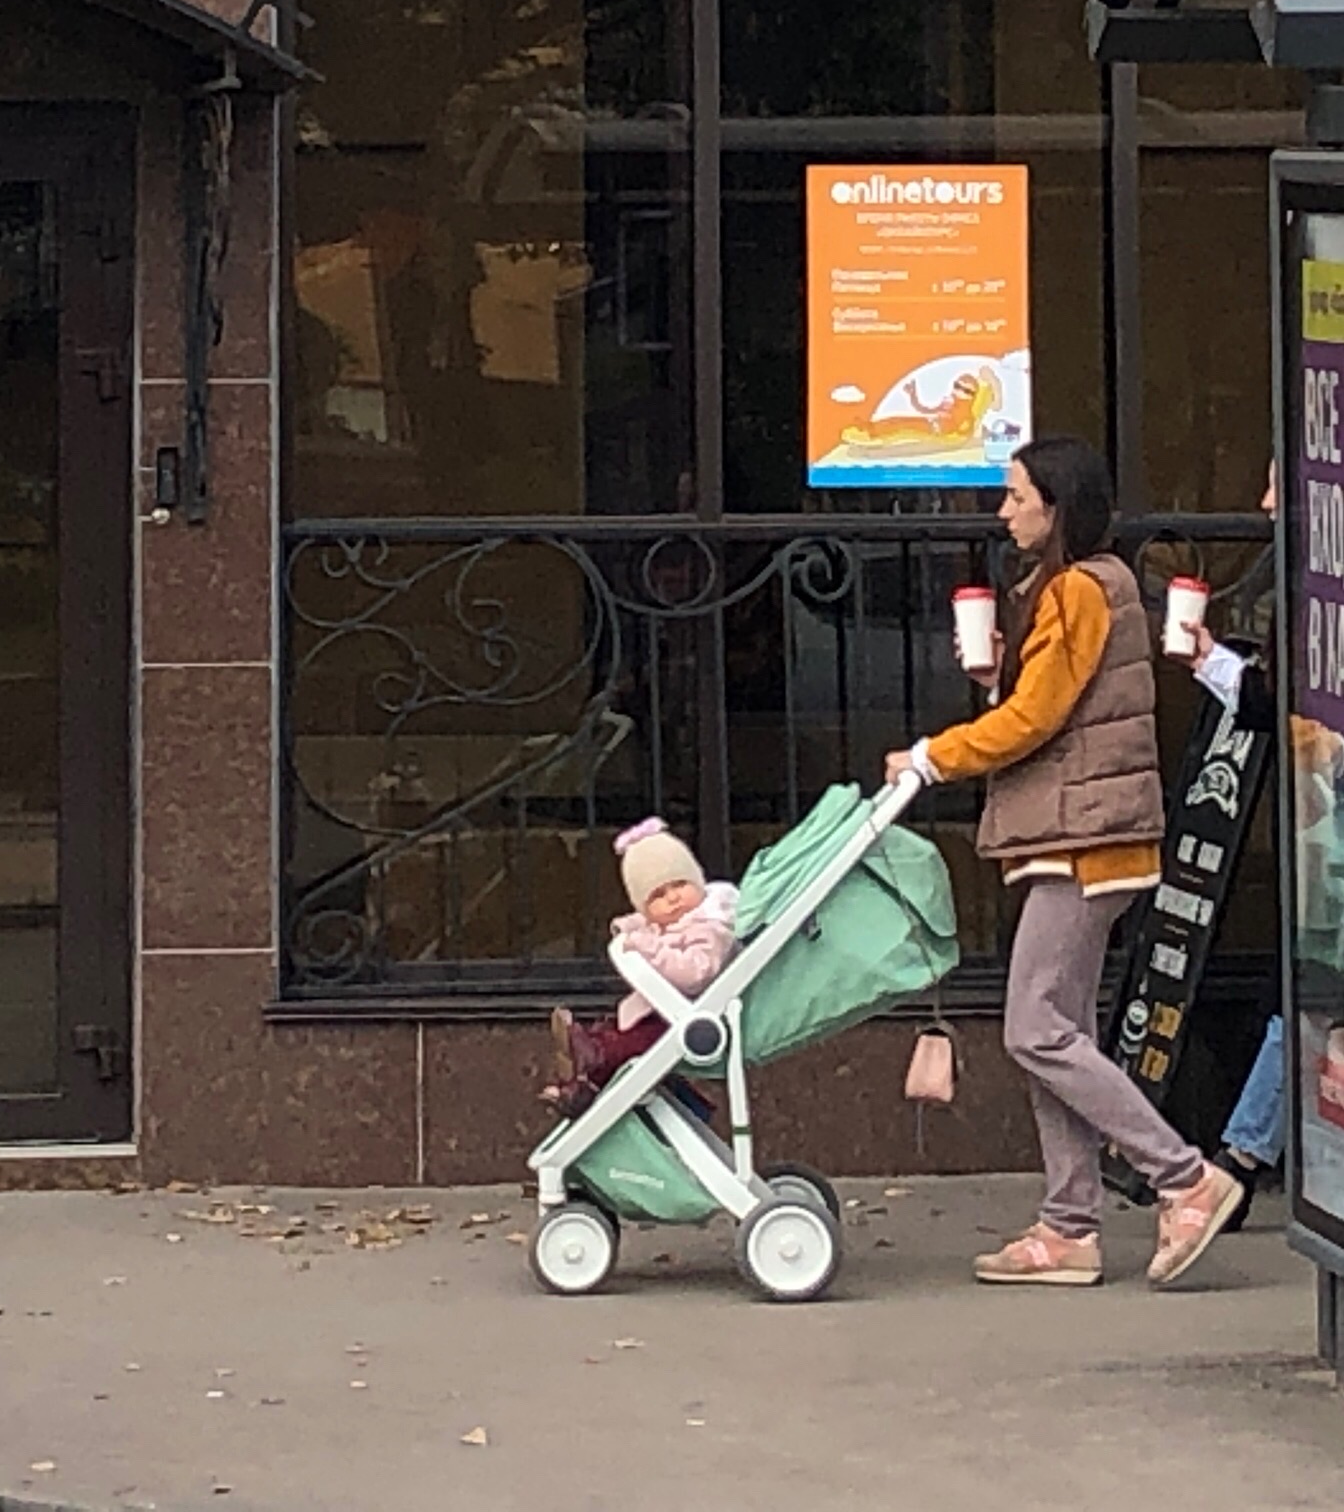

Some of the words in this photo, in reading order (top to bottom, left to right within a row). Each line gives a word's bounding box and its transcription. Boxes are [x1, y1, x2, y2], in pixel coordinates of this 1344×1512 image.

[831, 174, 1004, 204] onlinetours
[1305, 368, 1342, 464] ВСЕ
[1308, 597, 1322, 691] В
